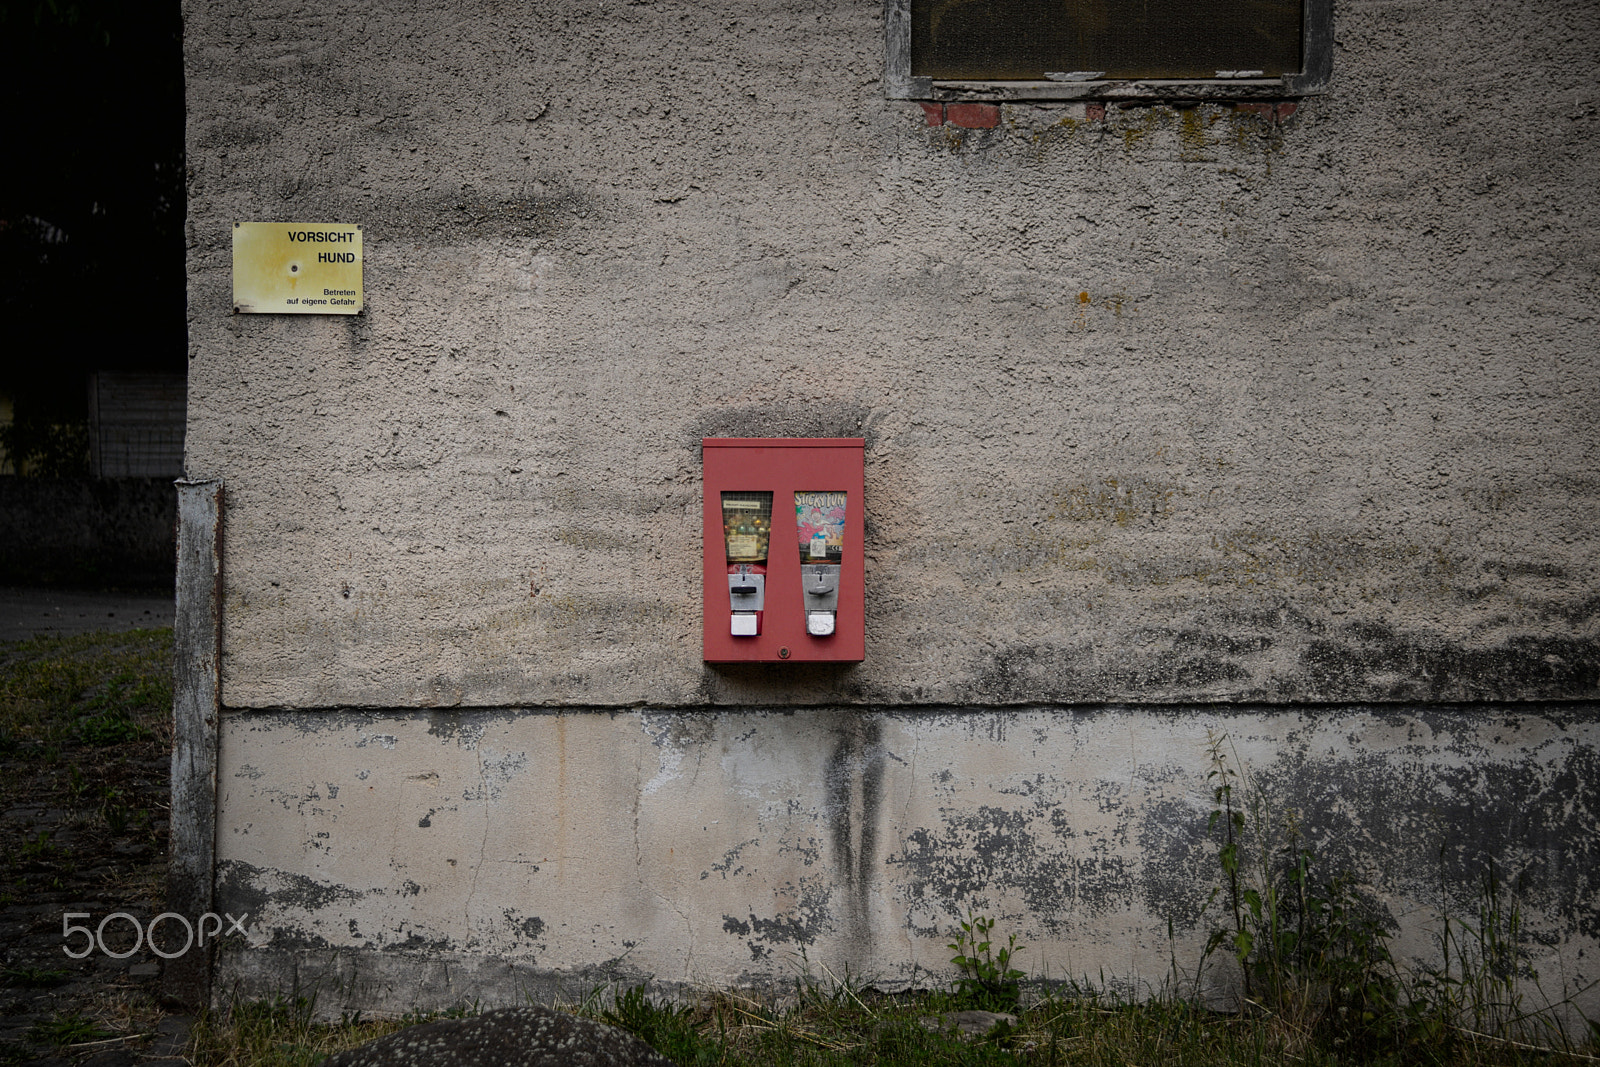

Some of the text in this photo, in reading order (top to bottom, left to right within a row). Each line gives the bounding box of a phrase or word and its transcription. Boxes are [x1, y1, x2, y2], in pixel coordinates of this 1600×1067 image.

[288, 231, 355, 243] VORSICHT
[318, 252, 355, 263] HUND
[323, 288, 356, 296] Betreten
[301, 297, 327, 306] eigene
[330, 298, 356, 306] Gefahr
